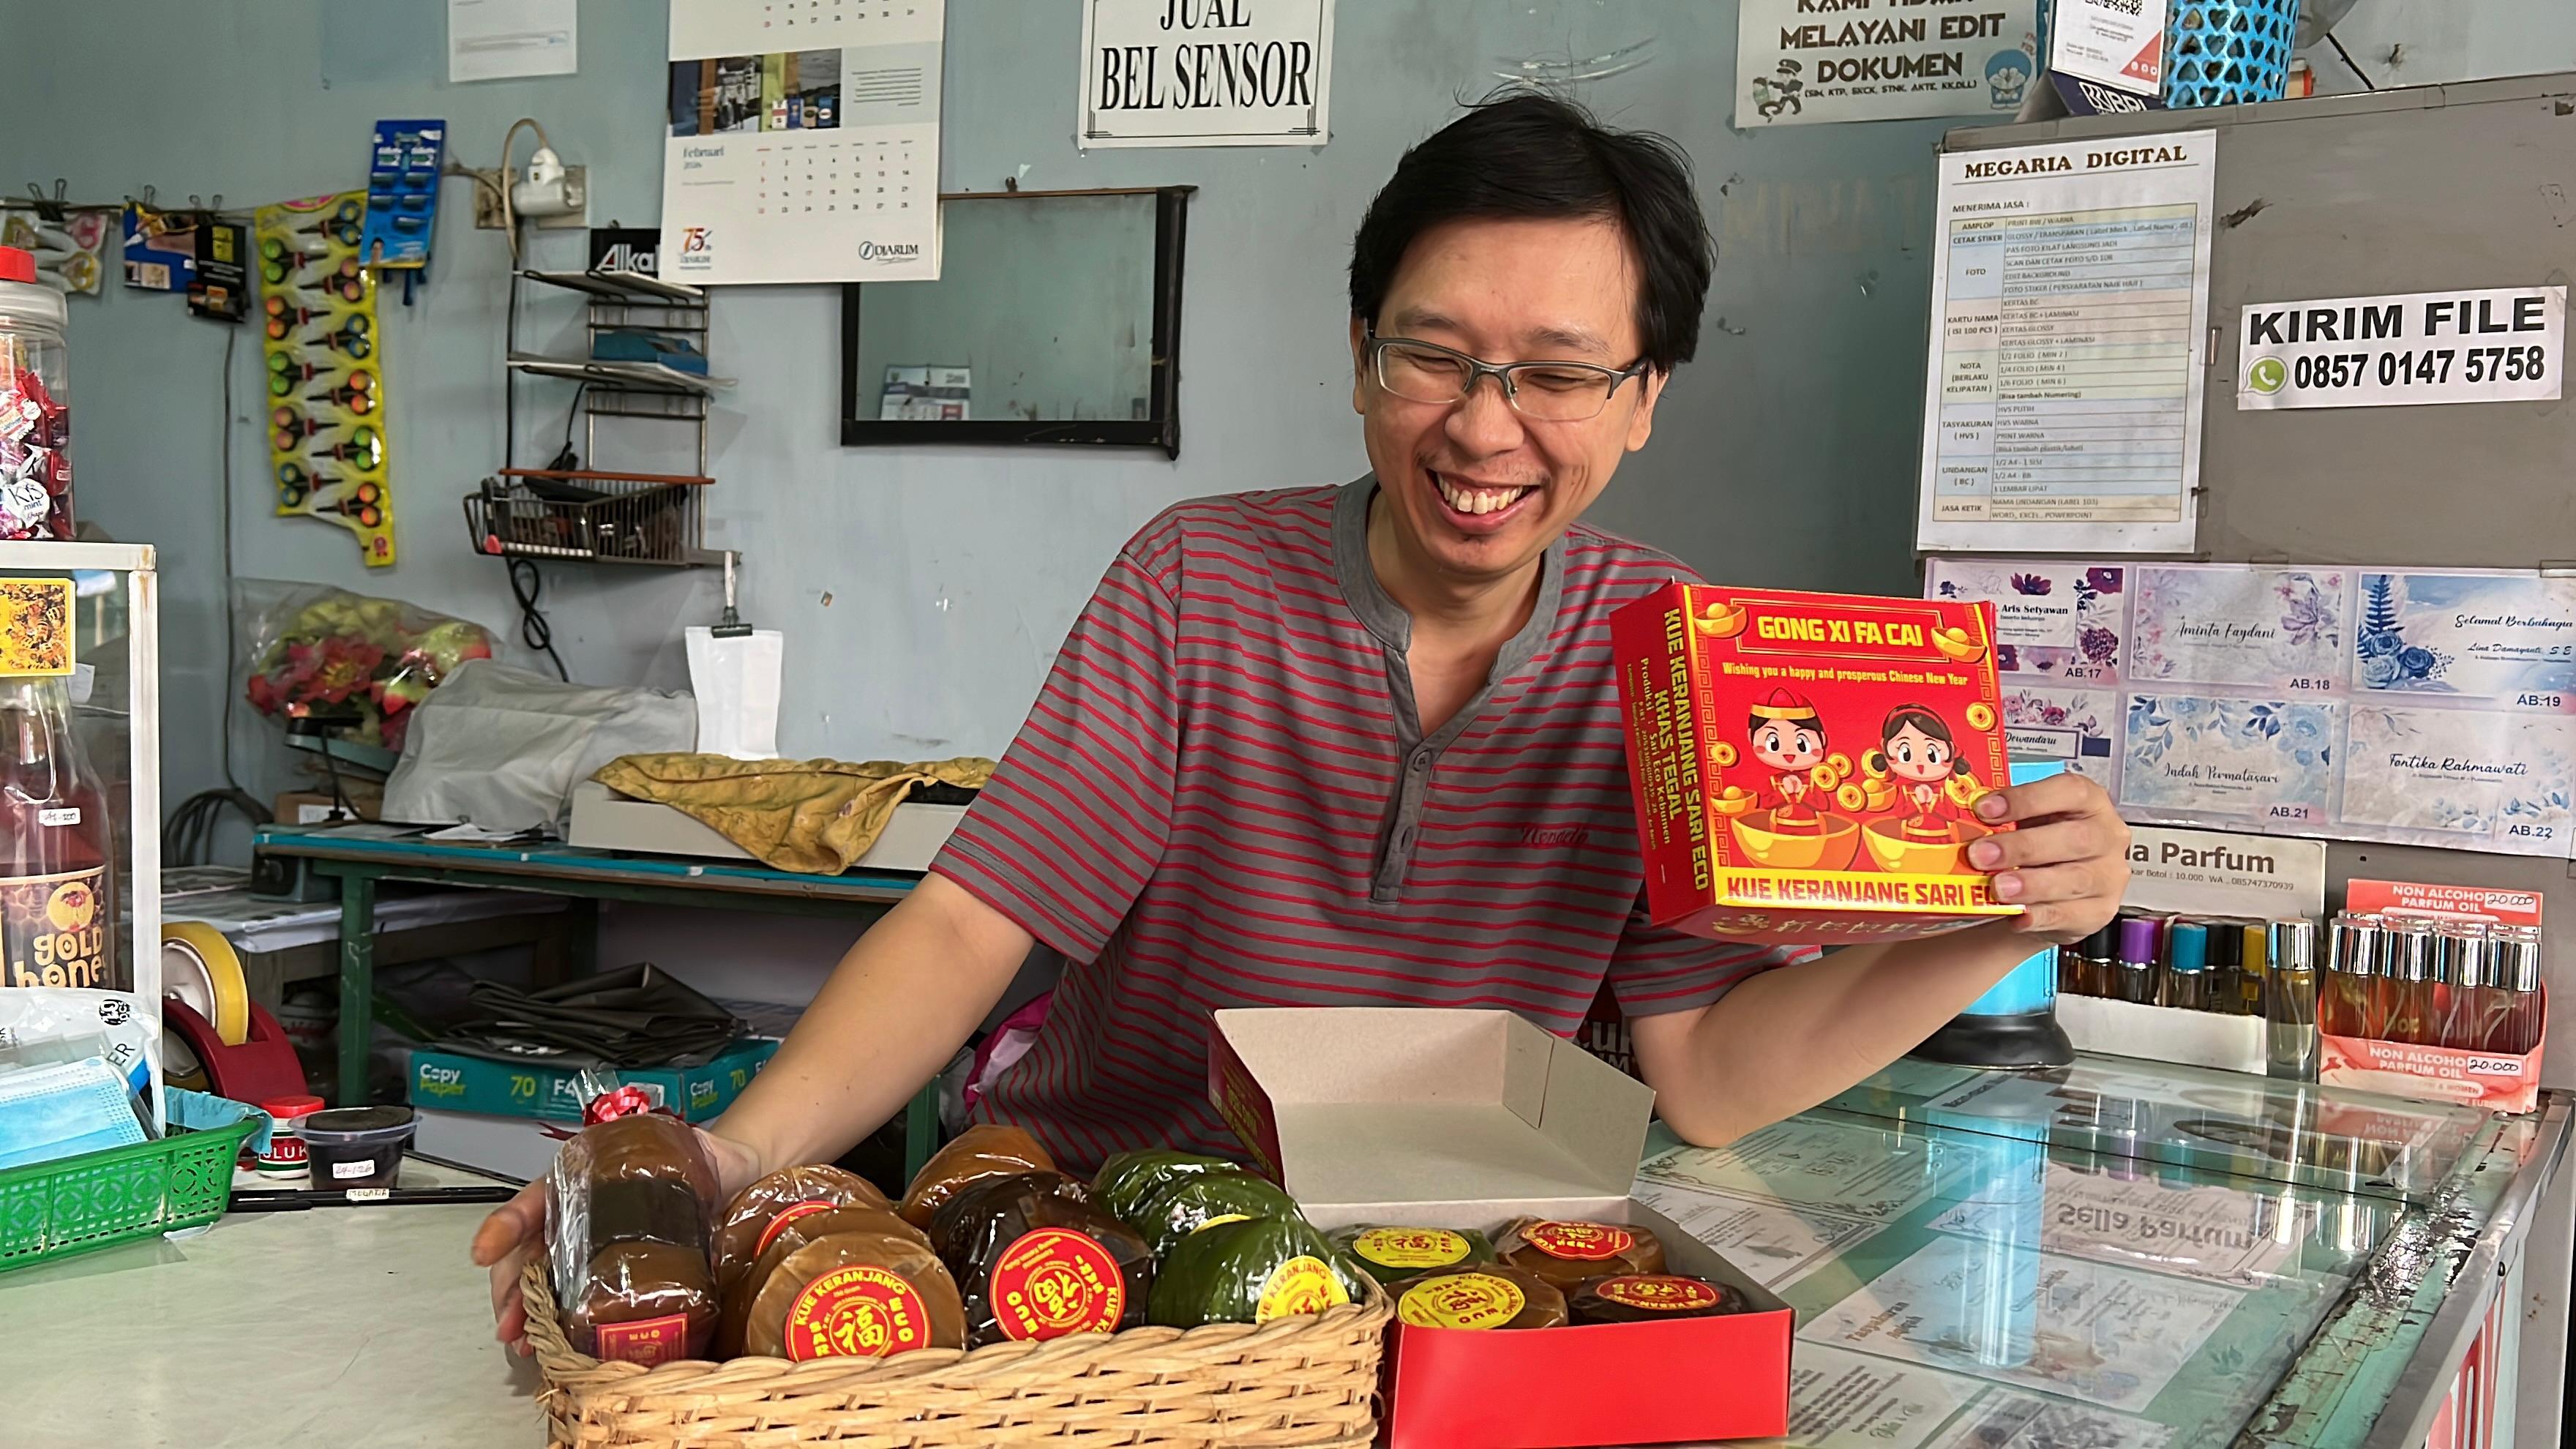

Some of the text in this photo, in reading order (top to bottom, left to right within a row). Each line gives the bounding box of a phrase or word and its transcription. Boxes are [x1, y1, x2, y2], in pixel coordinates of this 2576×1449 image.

[1781, 12, 2006, 49] MELAYANI EDIT
[1099, 41, 1312, 111] BEL SENSOR
[1817, 52, 1963, 83] DOKUMEN
[2104, 89, 2148, 113] BRI
[1964, 146, 2187, 179] MEGARIA DIGITAL
[1952, 199, 2026, 213] MENERIMA JASA
[1961, 221, 1995, 231] AMPLOP
[1952, 233, 2003, 244] CETAK STIKER
[875, 244, 919, 256] DJARUM
[2006, 245, 2019, 254] PAS
[1965, 268, 1986, 276] FOTO
[2004, 285, 2023, 293] FOTO
[1974, 315, 1999, 323] NAMA
[2249, 296, 2546, 345] KIRIM FILE
[1952, 326, 1993, 335] ISI 100 PCS
[2294, 345, 2545, 389] 0857 0147 5758
[1952, 374, 1988, 382] (BERLAKU
[1946, 385, 1988, 393] KELIPATAN
[1942, 420, 1993, 428] TASYAKURAN
[1959, 478, 1969, 486] BC
[1941, 504, 1982, 512] JASA KETIK
[2023, 604, 2069, 615] Setyawan
[1757, 615, 1924, 647] GONG XI FA CAI
[2455, 614, 2573, 632] Selamat Berbahagia
[2467, 643, 2490, 651] Lina
[1722, 662, 1760, 679] Wishing
[1761, 666, 1779, 678] you
[1789, 666, 1816, 682] happy
[1818, 667, 1835, 680] and
[1837, 670, 1887, 683] prosperous
[1889, 670, 1924, 684] Chinese
[1925, 672, 1946, 685] New
[1948, 673, 1968, 686] Year
[2064, 667, 2103, 679] AB.17
[2289, 678, 2331, 690] AB.18
[2516, 694, 2561, 707] AB.19
[1640, 657, 1671, 845] Produksi Sari Eco Kebumen
[1654, 689, 1683, 821] KHAS TEGAL
[1663, 607, 1710, 891] KUE KERANJANG SARI ECO
[2164, 762, 2280, 783] Indah Permatasari
[2441, 757, 2528, 776] Rahmawati
[2269, 806, 2310, 820] AB.21
[2508, 824, 2553, 839] AB.22
[2160, 842, 2274, 874] Parfum
[2146, 869, 2167, 879] Botol
[2176, 872, 2204, 883] 10.000
[2209, 875, 2223, 884] WA
[1728, 877, 1772, 901] KUE
[1778, 878, 1909, 905] KERANJANG
[1914, 883, 1966, 906] SARI
[2392, 885, 2486, 902] NON ALCOHO
[2400, 896, 2482, 913] PARFUM OIL
[2369, 1046, 2466, 1068] NON ALCOHO
[2469, 1058, 2519, 1072] 20.000
[729, 1068, 746, 1090] 70
[2379, 1060, 2463, 1079] PARFUM OIL
[419, 1063, 461, 1085] Copy
[510, 1076, 536, 1097] 70
[419, 1077, 465, 1097] Paper
[1269, 1263, 1327, 1298] KERANJANG
[795, 1294, 818, 1325] KUE
[813, 1270, 907, 1297] KERANJANG
[1033, 1270, 1081, 1319] 福
[1103, 1287, 1118, 1319] KUE
[888, 1296, 914, 1343] ECO
[1006, 1290, 1040, 1335] ECO
[833, 1304, 884, 1354] 福
